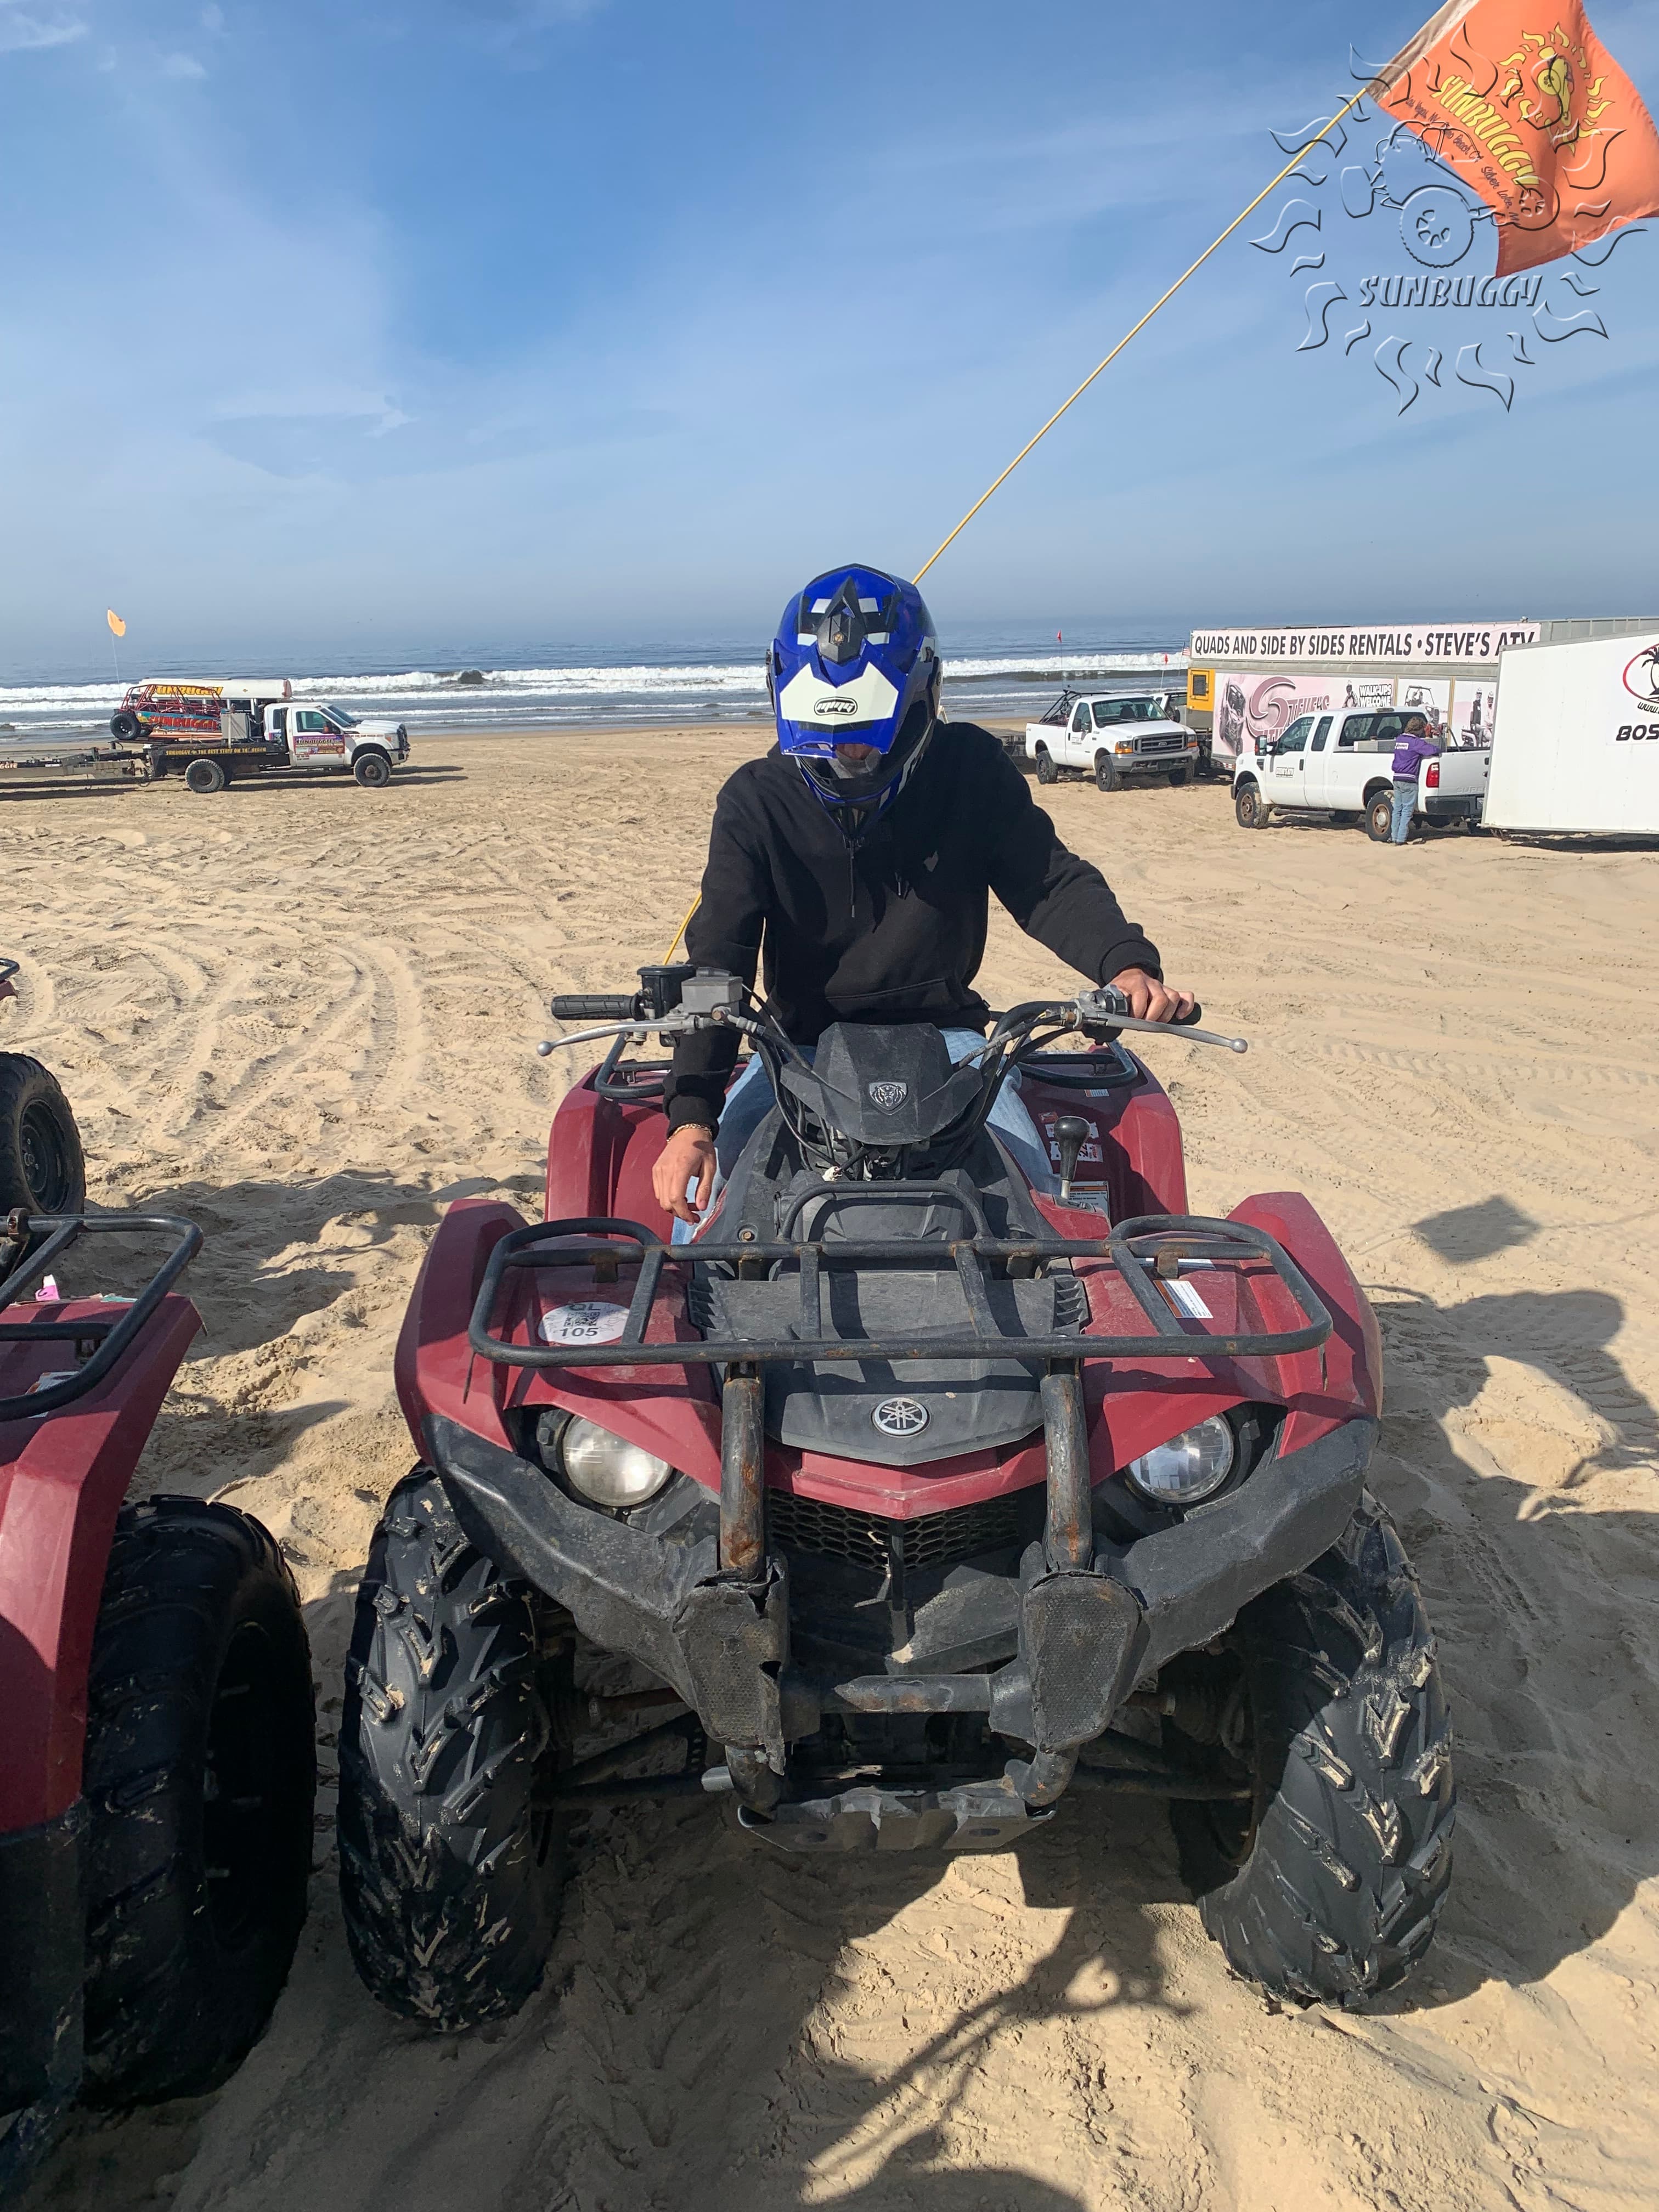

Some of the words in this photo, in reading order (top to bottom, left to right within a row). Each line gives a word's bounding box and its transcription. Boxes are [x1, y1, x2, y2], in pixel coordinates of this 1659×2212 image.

[1430, 75, 1539, 185] SUNBUGGY
[1453, 134, 1474, 155] Beach
[1481, 166, 1500, 190] Silver
[1195, 635, 1230, 655] QUADS
[1233, 635, 1257, 654] AND
[1261, 635, 1286, 655] SIDE
[1290, 635, 1306, 655] BY
[1308, 634, 1345, 656] SIDES
[1349, 633, 1413, 656] RENTALS
[1425, 632, 1491, 656] STEVE'S
[1359, 684, 1392, 696] WALK-UPS
[1359, 696, 1391, 707] WELCOME
[559, 1328, 600, 1336] 105
